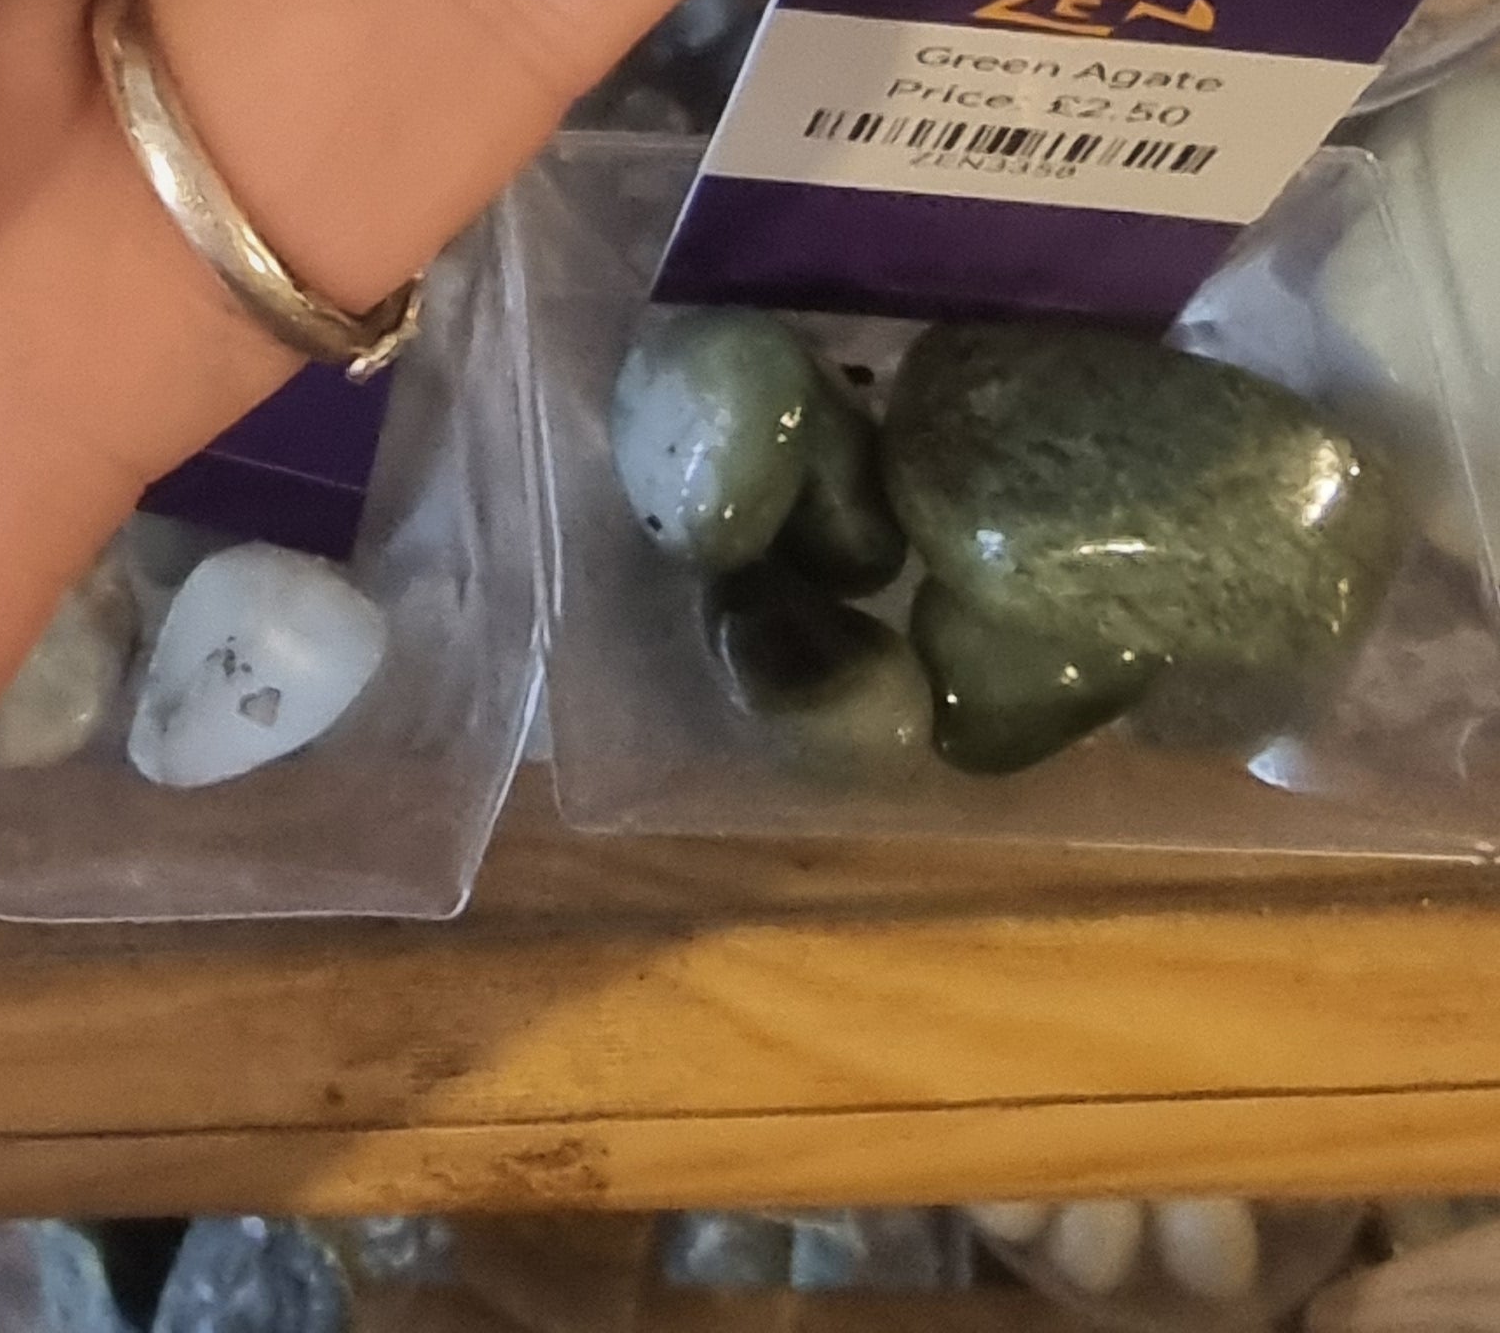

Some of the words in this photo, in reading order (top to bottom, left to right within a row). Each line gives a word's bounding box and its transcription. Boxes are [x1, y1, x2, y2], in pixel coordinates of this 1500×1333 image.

[915, 46, 1061, 78] Green
[1073, 61, 1224, 92] Agate
[1047, 94, 1191, 126] £2.50
